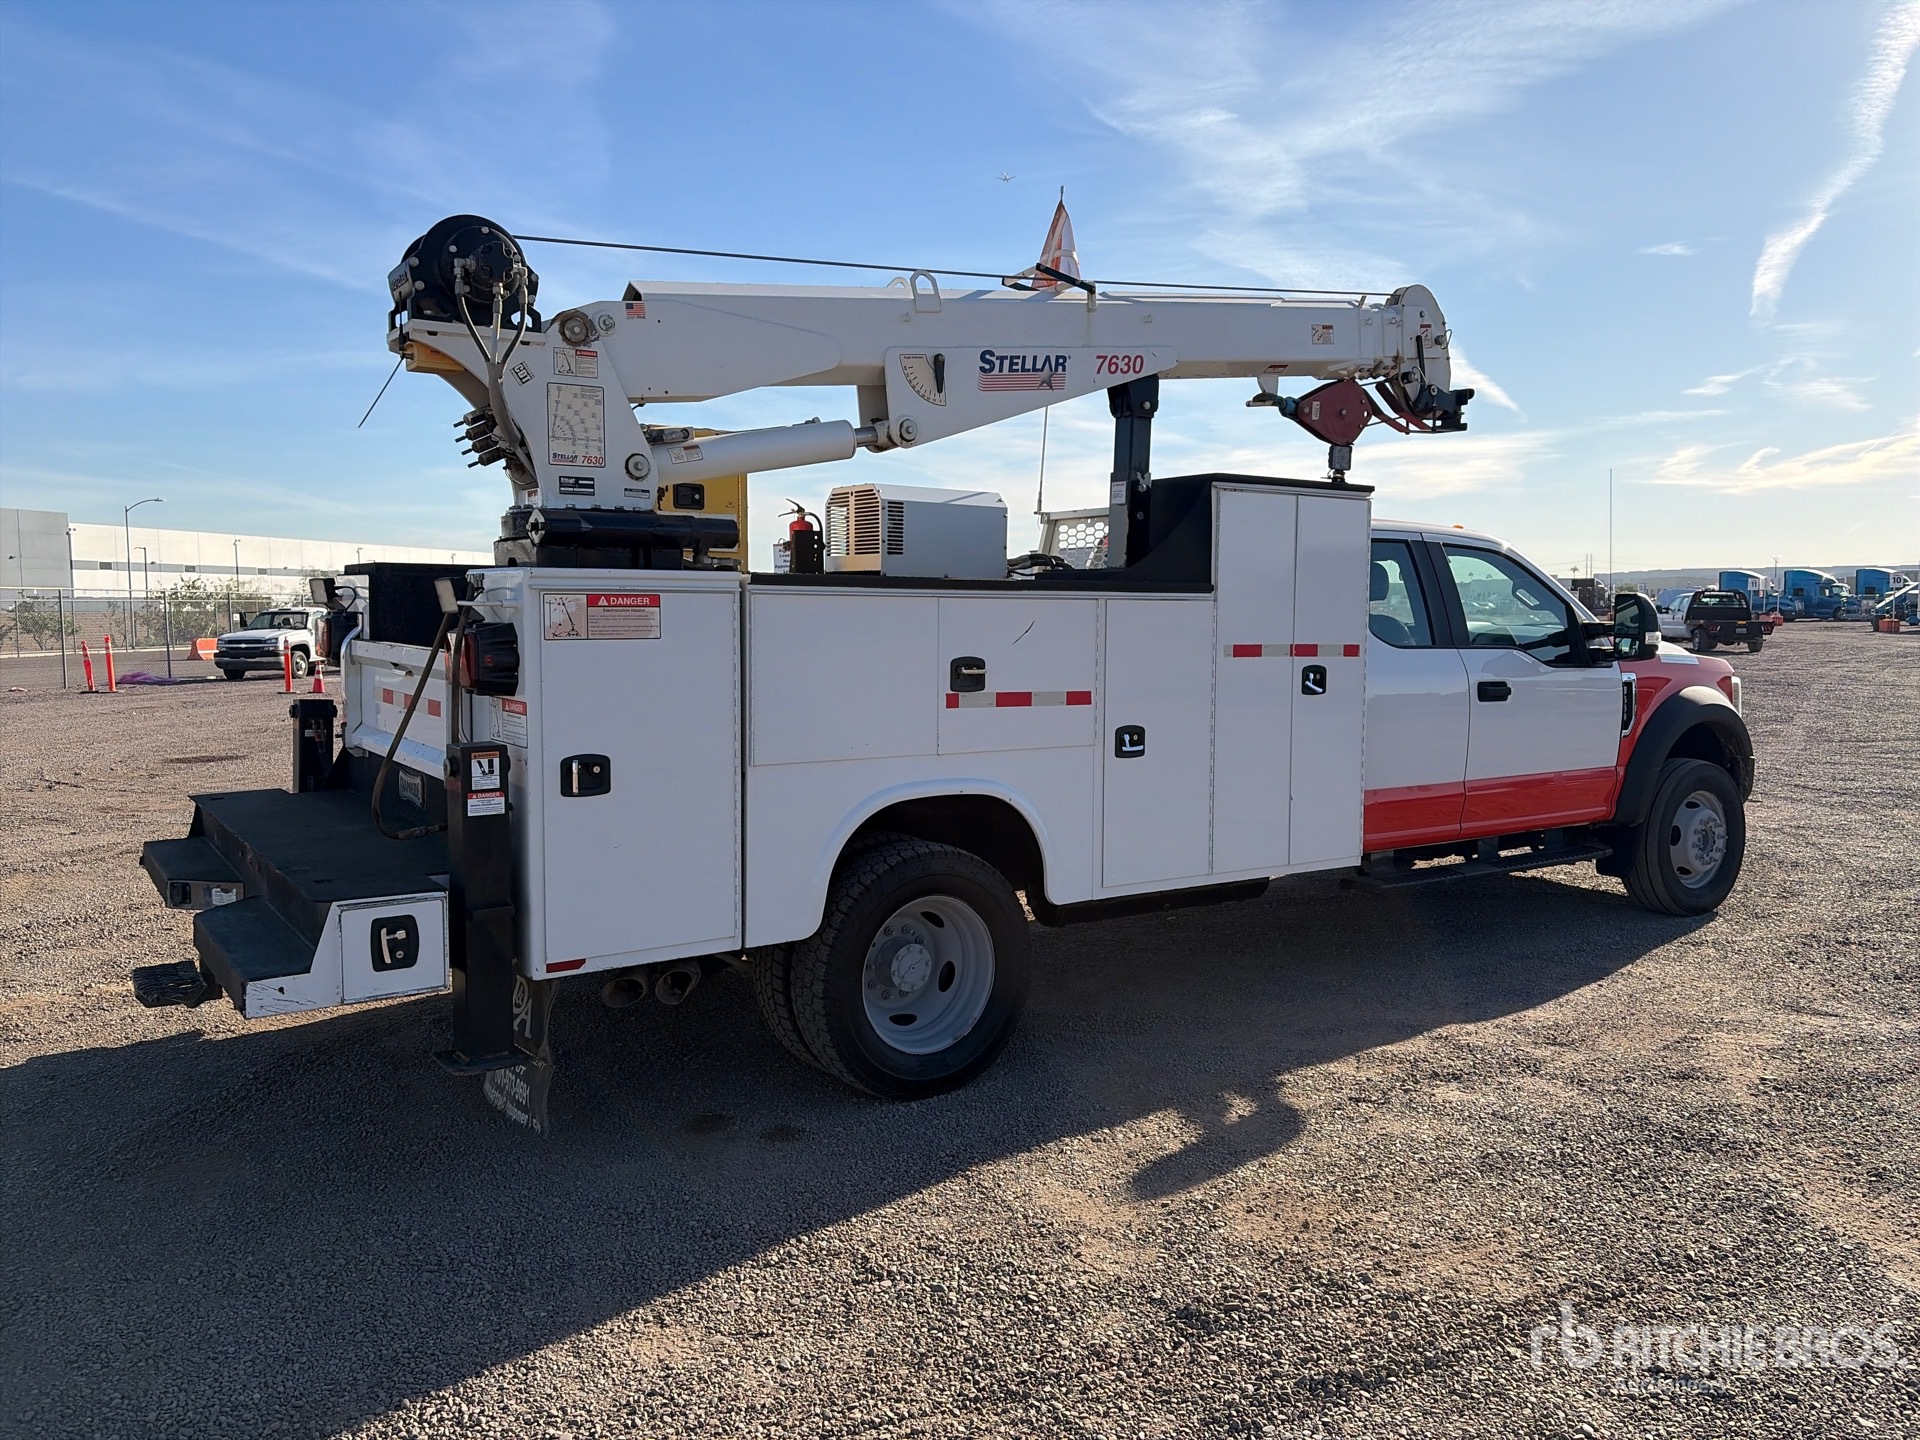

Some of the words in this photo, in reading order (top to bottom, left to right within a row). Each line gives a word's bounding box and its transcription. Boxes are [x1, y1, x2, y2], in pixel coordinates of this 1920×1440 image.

[979, 349, 1067, 374] STELLAR
[1095, 354, 1144, 375] 7630
[514, 364, 532, 383] CDT
[552, 452, 578, 460] STELLAR
[581, 455, 604, 465] 7630
[1892, 576, 1902, 584] 10
[610, 597, 650, 606] DANGER
[508, 702, 523, 712] DANGER
